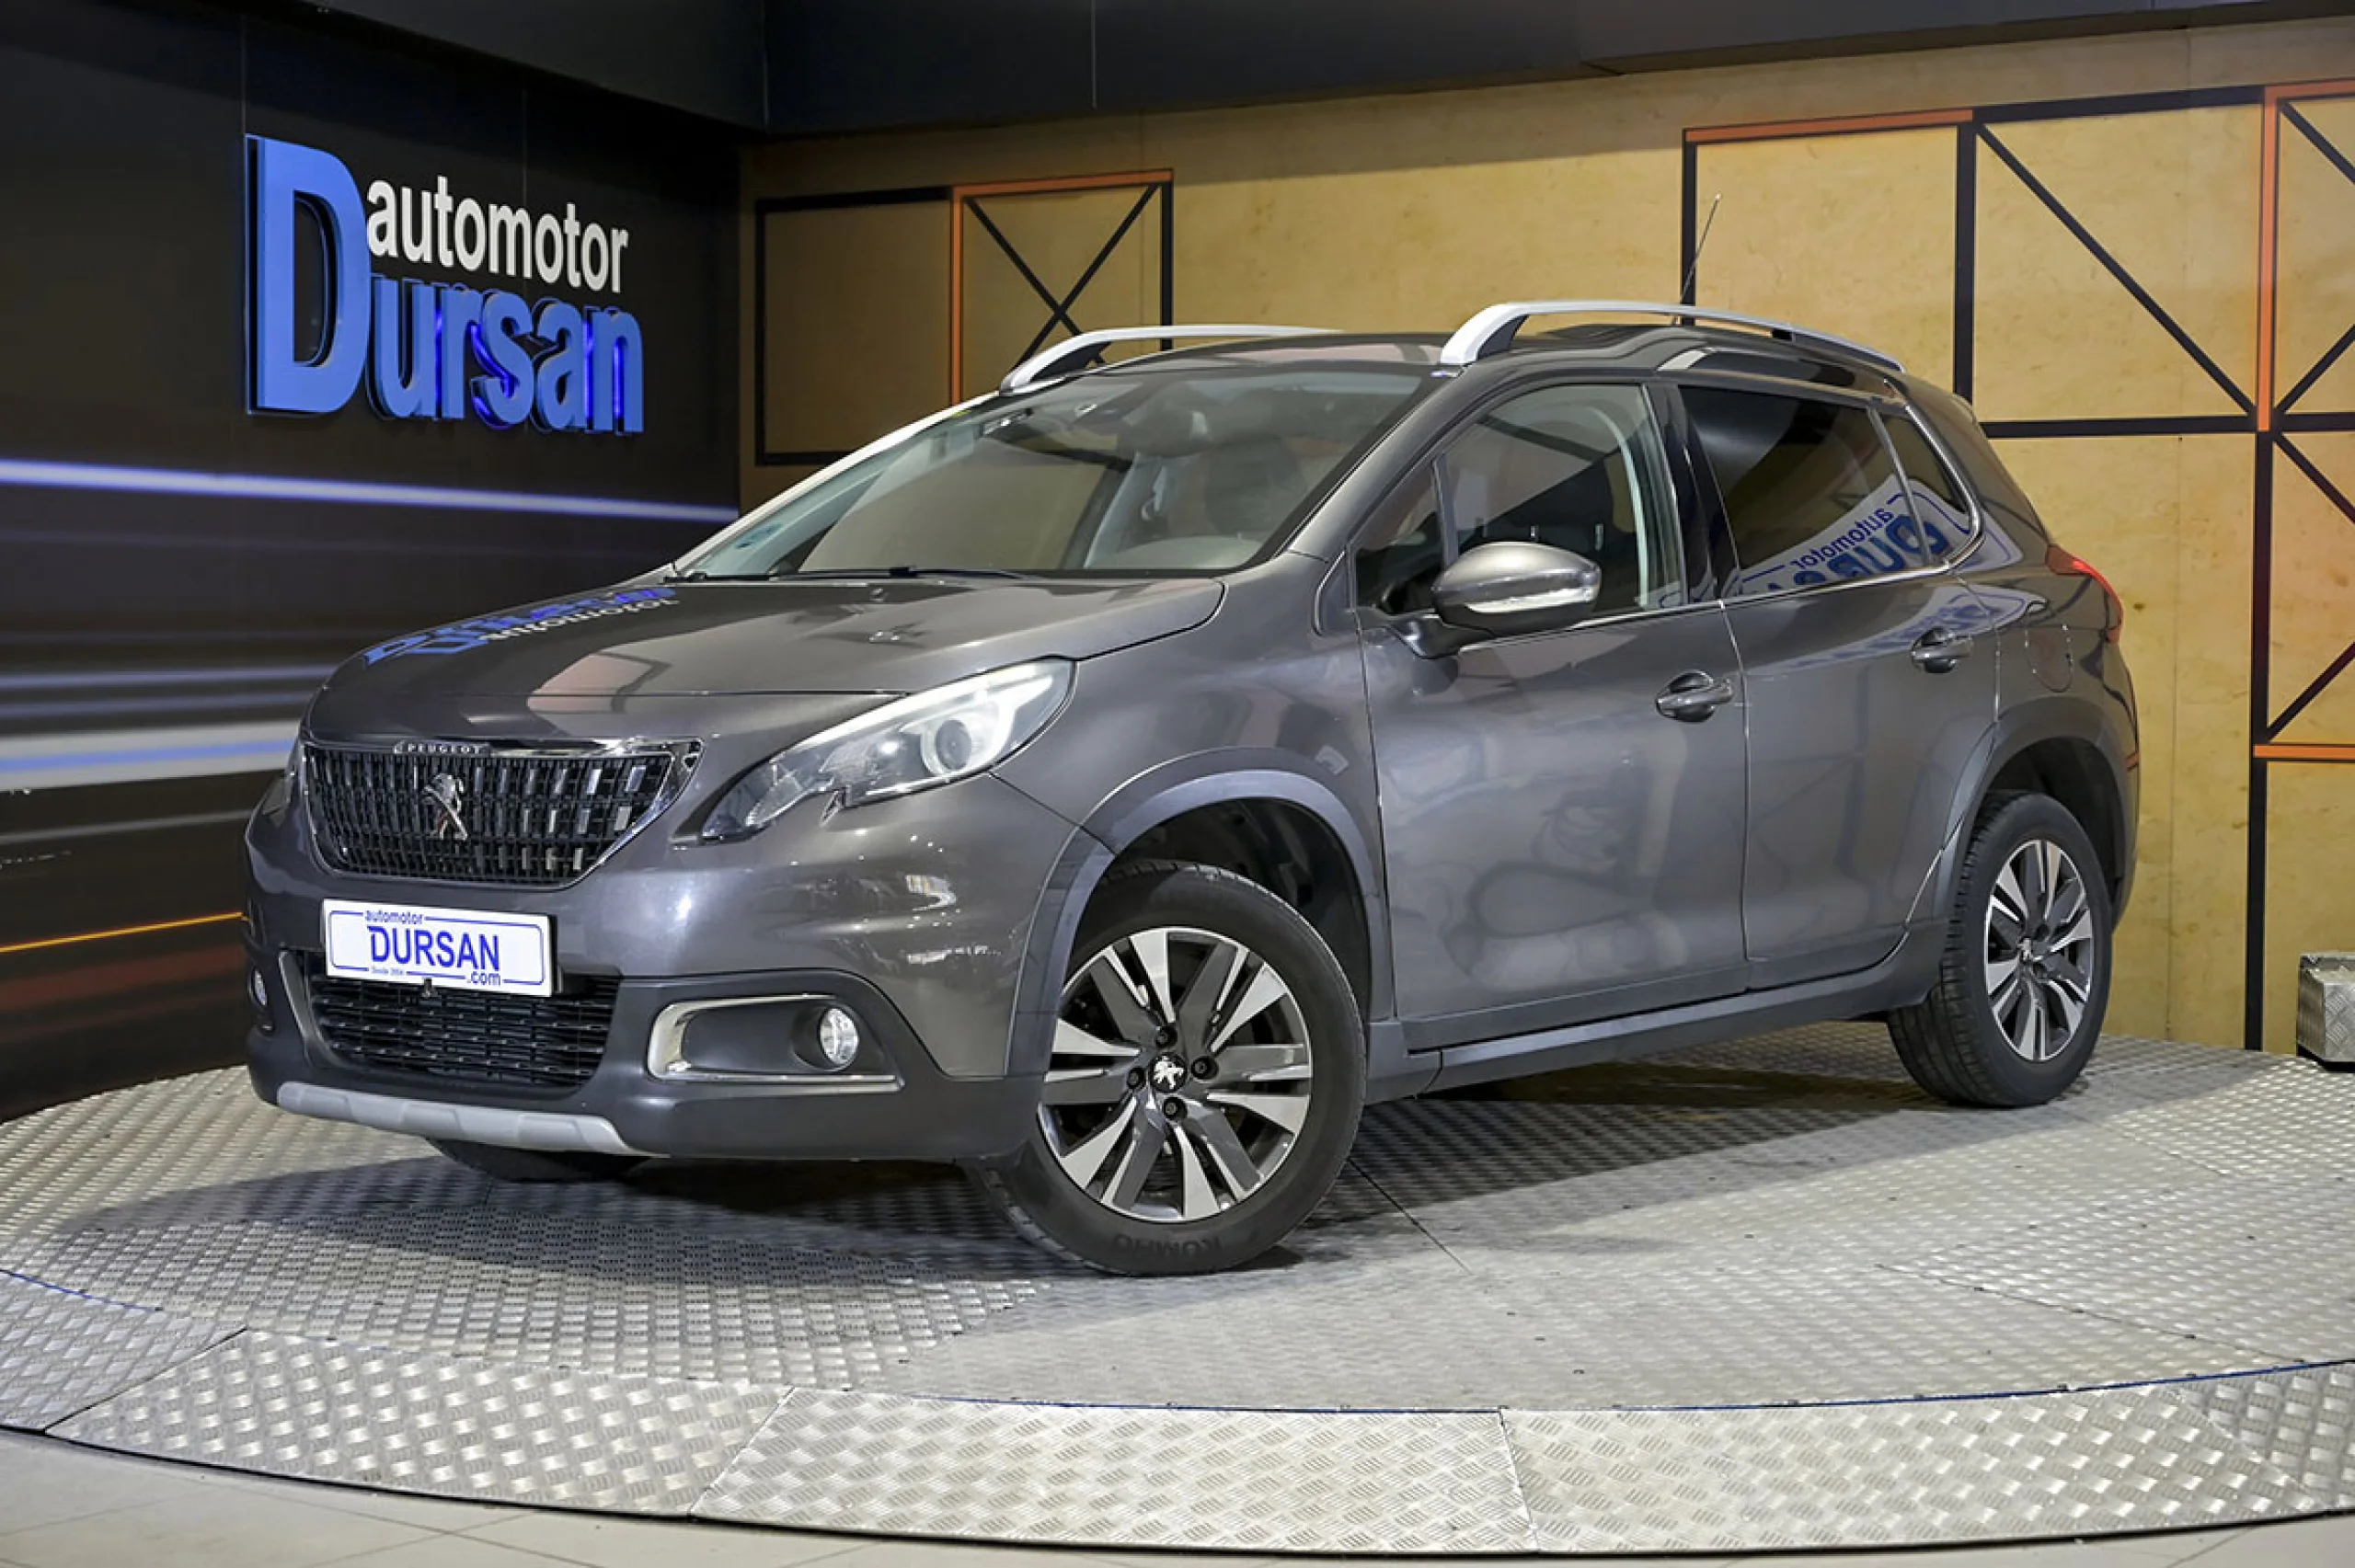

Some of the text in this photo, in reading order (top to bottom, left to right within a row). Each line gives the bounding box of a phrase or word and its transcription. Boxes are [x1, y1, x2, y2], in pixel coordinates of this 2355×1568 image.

[367, 176, 628, 292] automotor
[246, 133, 644, 437] Dursan
[407, 742, 484, 755] PEUGEOT
[364, 910, 424, 925] automotor
[367, 925, 500, 972] DURSAN
[466, 971, 501, 986] .com
